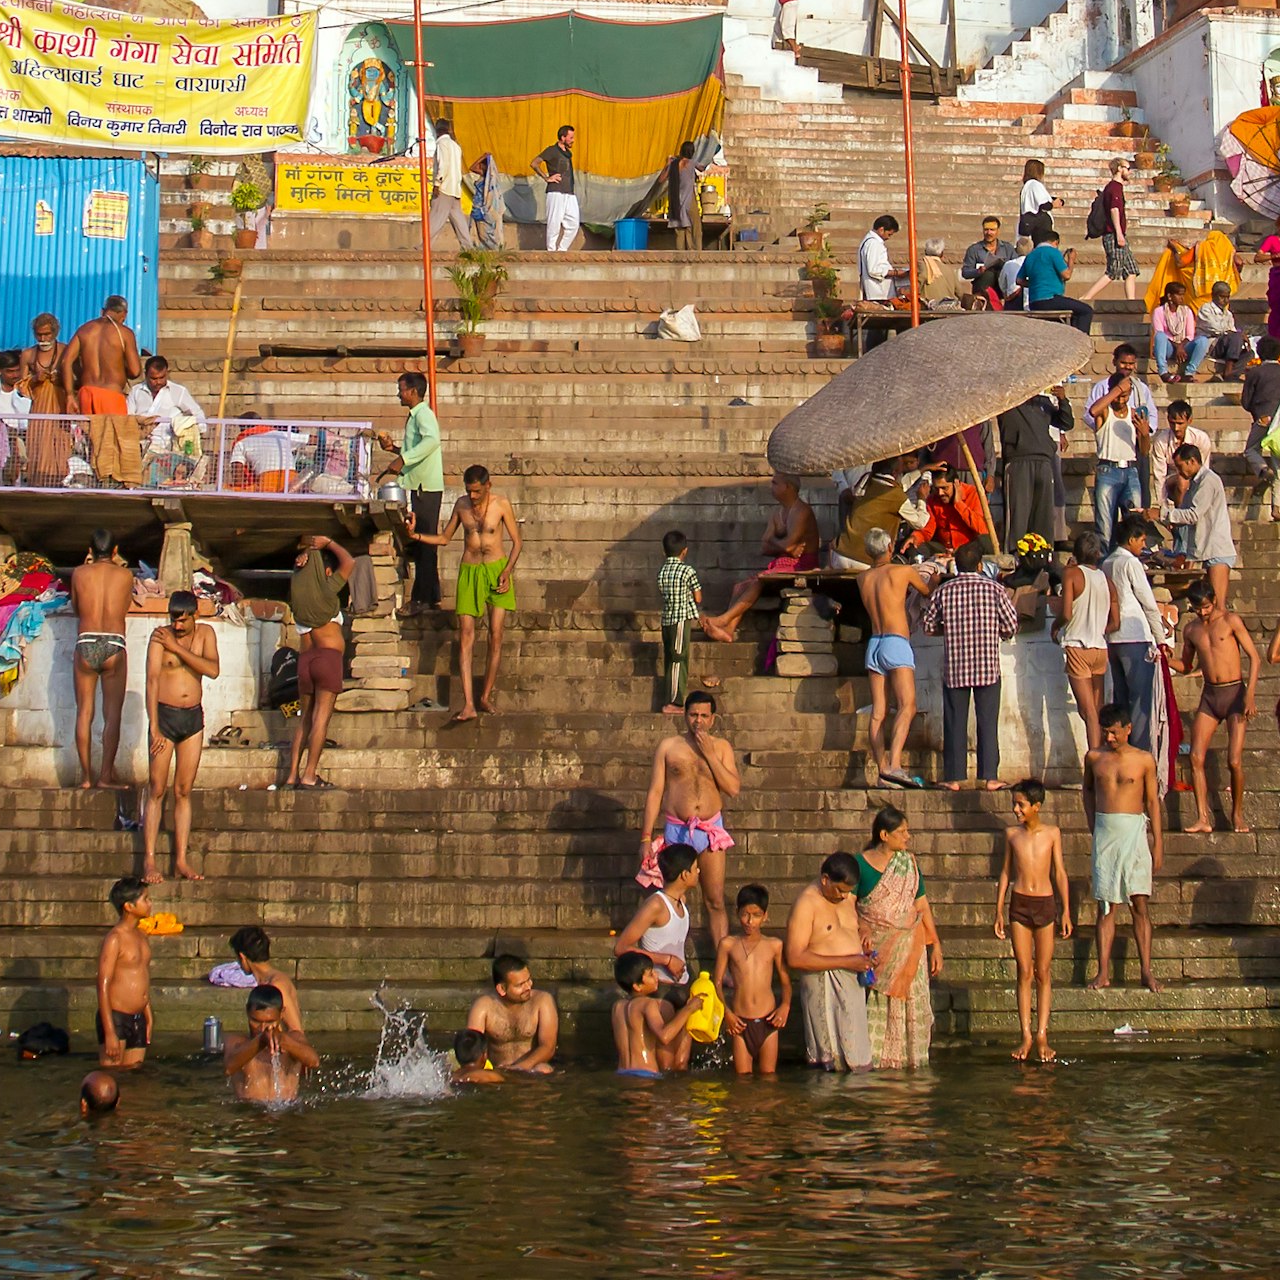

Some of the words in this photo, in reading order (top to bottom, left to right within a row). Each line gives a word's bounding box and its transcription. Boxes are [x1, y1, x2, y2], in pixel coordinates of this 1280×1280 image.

[34, 27, 98, 57] काशी
[110, 34, 160, 64] गंगा
[172, 35, 220, 65] सेवा
[232, 34, 302, 66] समिति
[10, 58, 103, 87] अहिल्याबाई
[113, 72, 144, 89] घाट
[175, 73, 247, 92] वाराणसी
[67, 111, 102, 129] विनय
[106, 115, 144, 136] कुमार
[147, 119, 187, 135] तिवारी
[200, 119, 237, 137] विनोद
[242, 123, 262, 137] राव
[234, 106, 268, 117] अध्यक्ष
[307, 167, 344, 183] गंगा
[353, 166, 369, 182] के
[290, 182, 326, 203] मुक्ति
[335, 183, 373, 203] मिले
[379, 188, 419, 206] पुकारे
